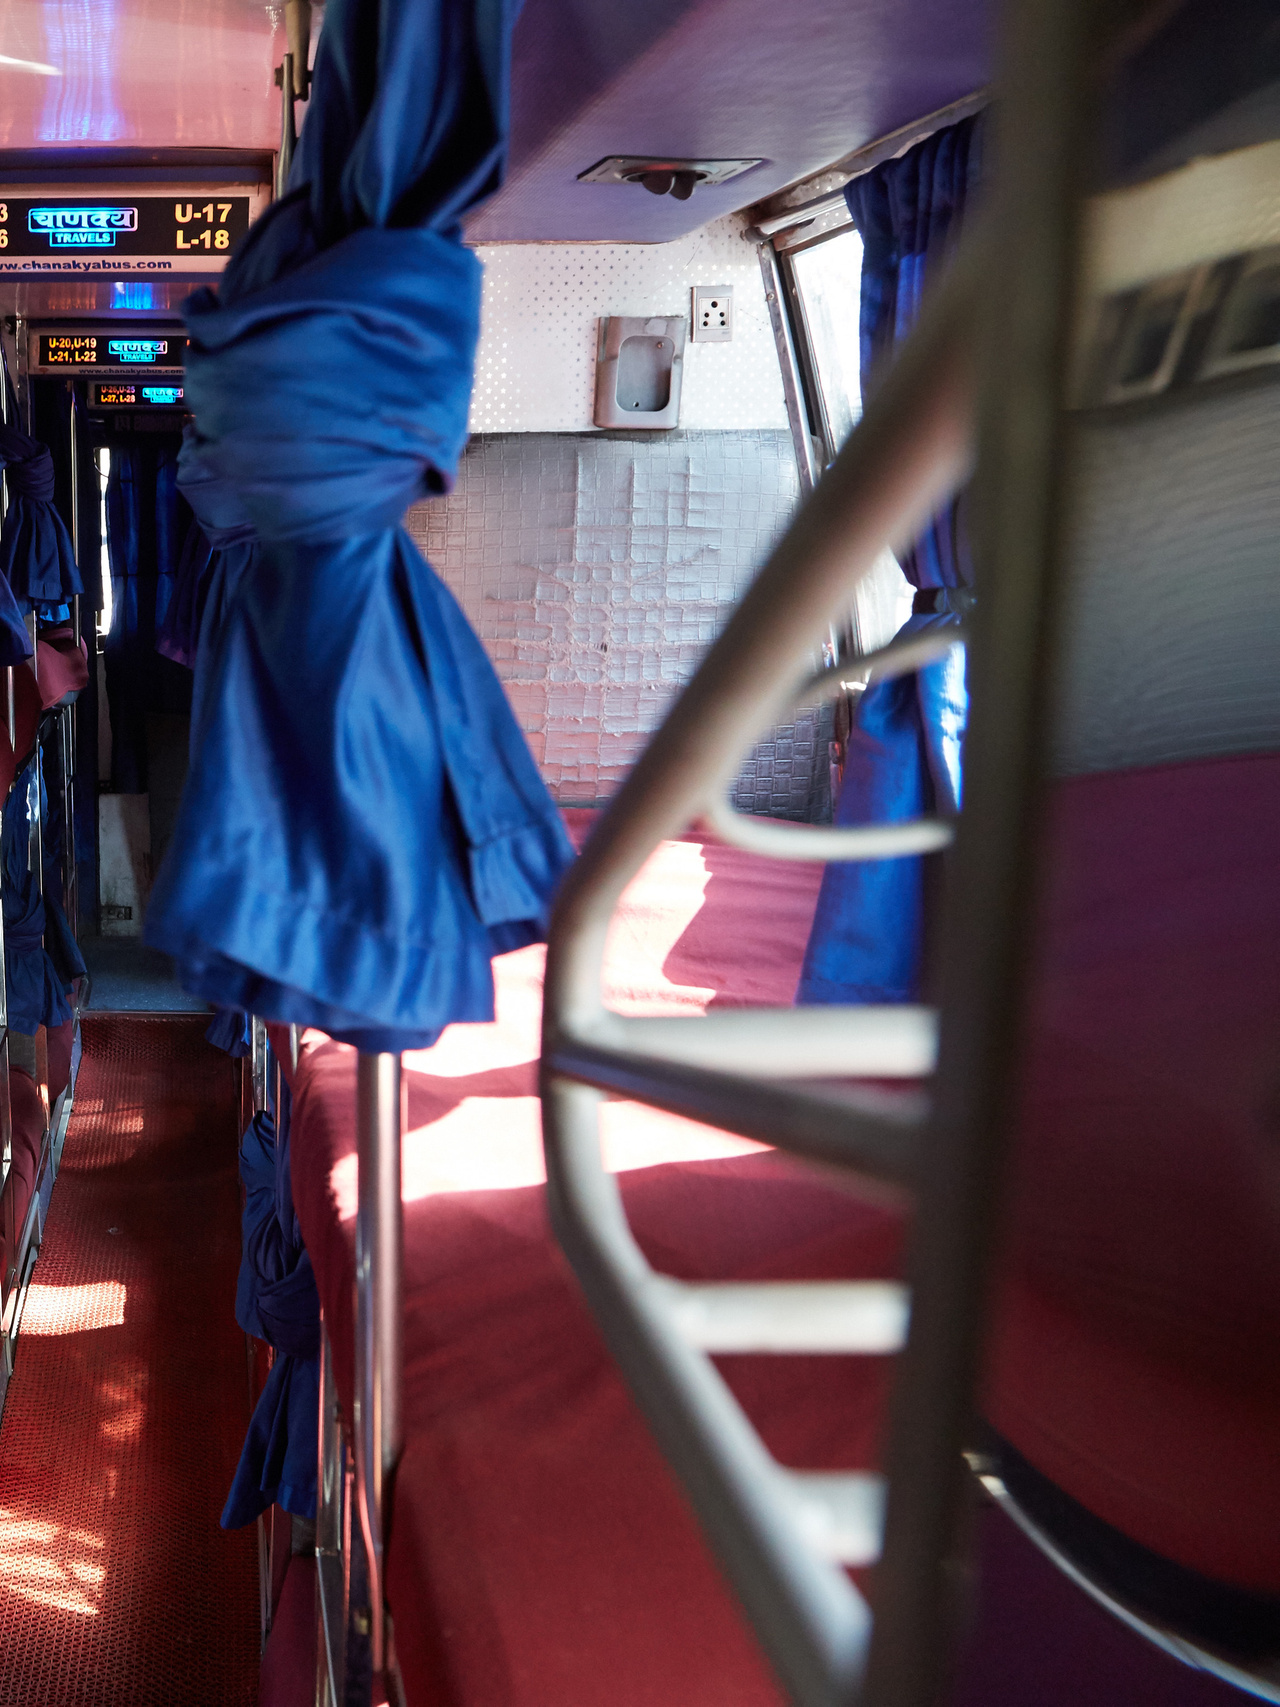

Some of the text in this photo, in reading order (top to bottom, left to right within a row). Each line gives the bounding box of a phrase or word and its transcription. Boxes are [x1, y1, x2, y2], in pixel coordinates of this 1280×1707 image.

[31, 210, 133, 228] चाणक्य
[174, 203, 233, 223] U-17
[55, 232, 111, 243] TRAVELS
[176, 229, 230, 249] L-18
[75, 351, 97, 362] L-22
